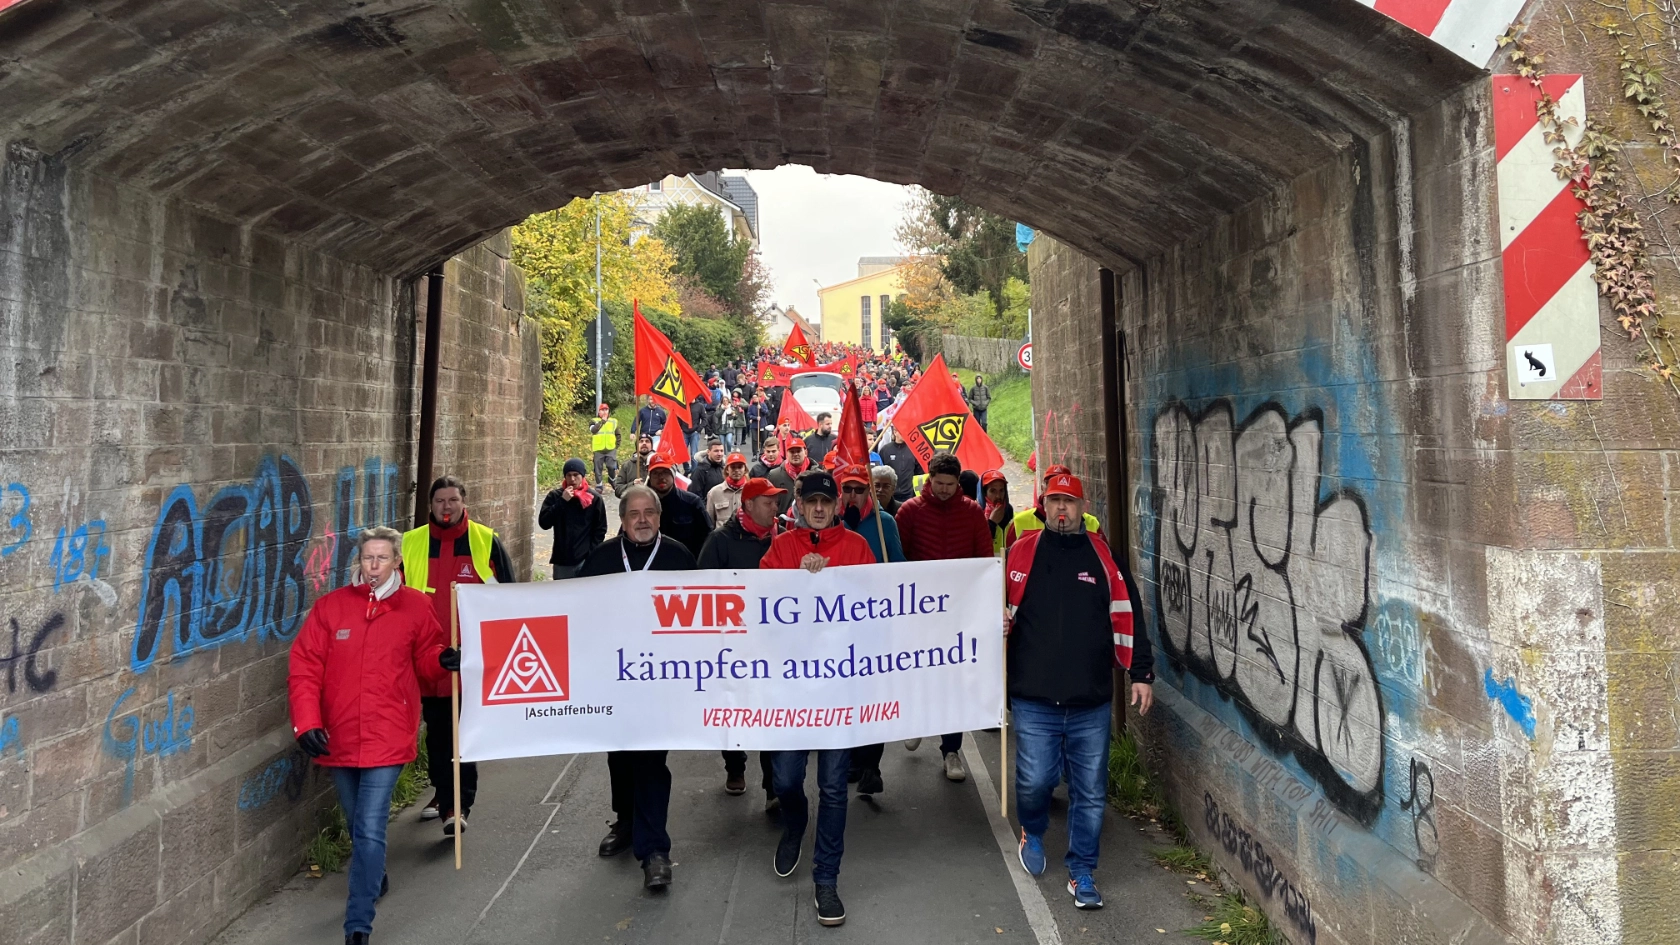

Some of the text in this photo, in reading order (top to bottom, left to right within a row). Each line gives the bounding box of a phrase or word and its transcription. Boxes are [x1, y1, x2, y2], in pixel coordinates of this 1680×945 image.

[50, 520, 111, 593] 187
[131, 454, 314, 674] ACAB
[652, 582, 950, 628] WIR IG Metaller
[616, 631, 980, 692] kämpfen ausdauernd!
[702, 701, 901, 728] VERTRAUENSLEUTE WIKA
